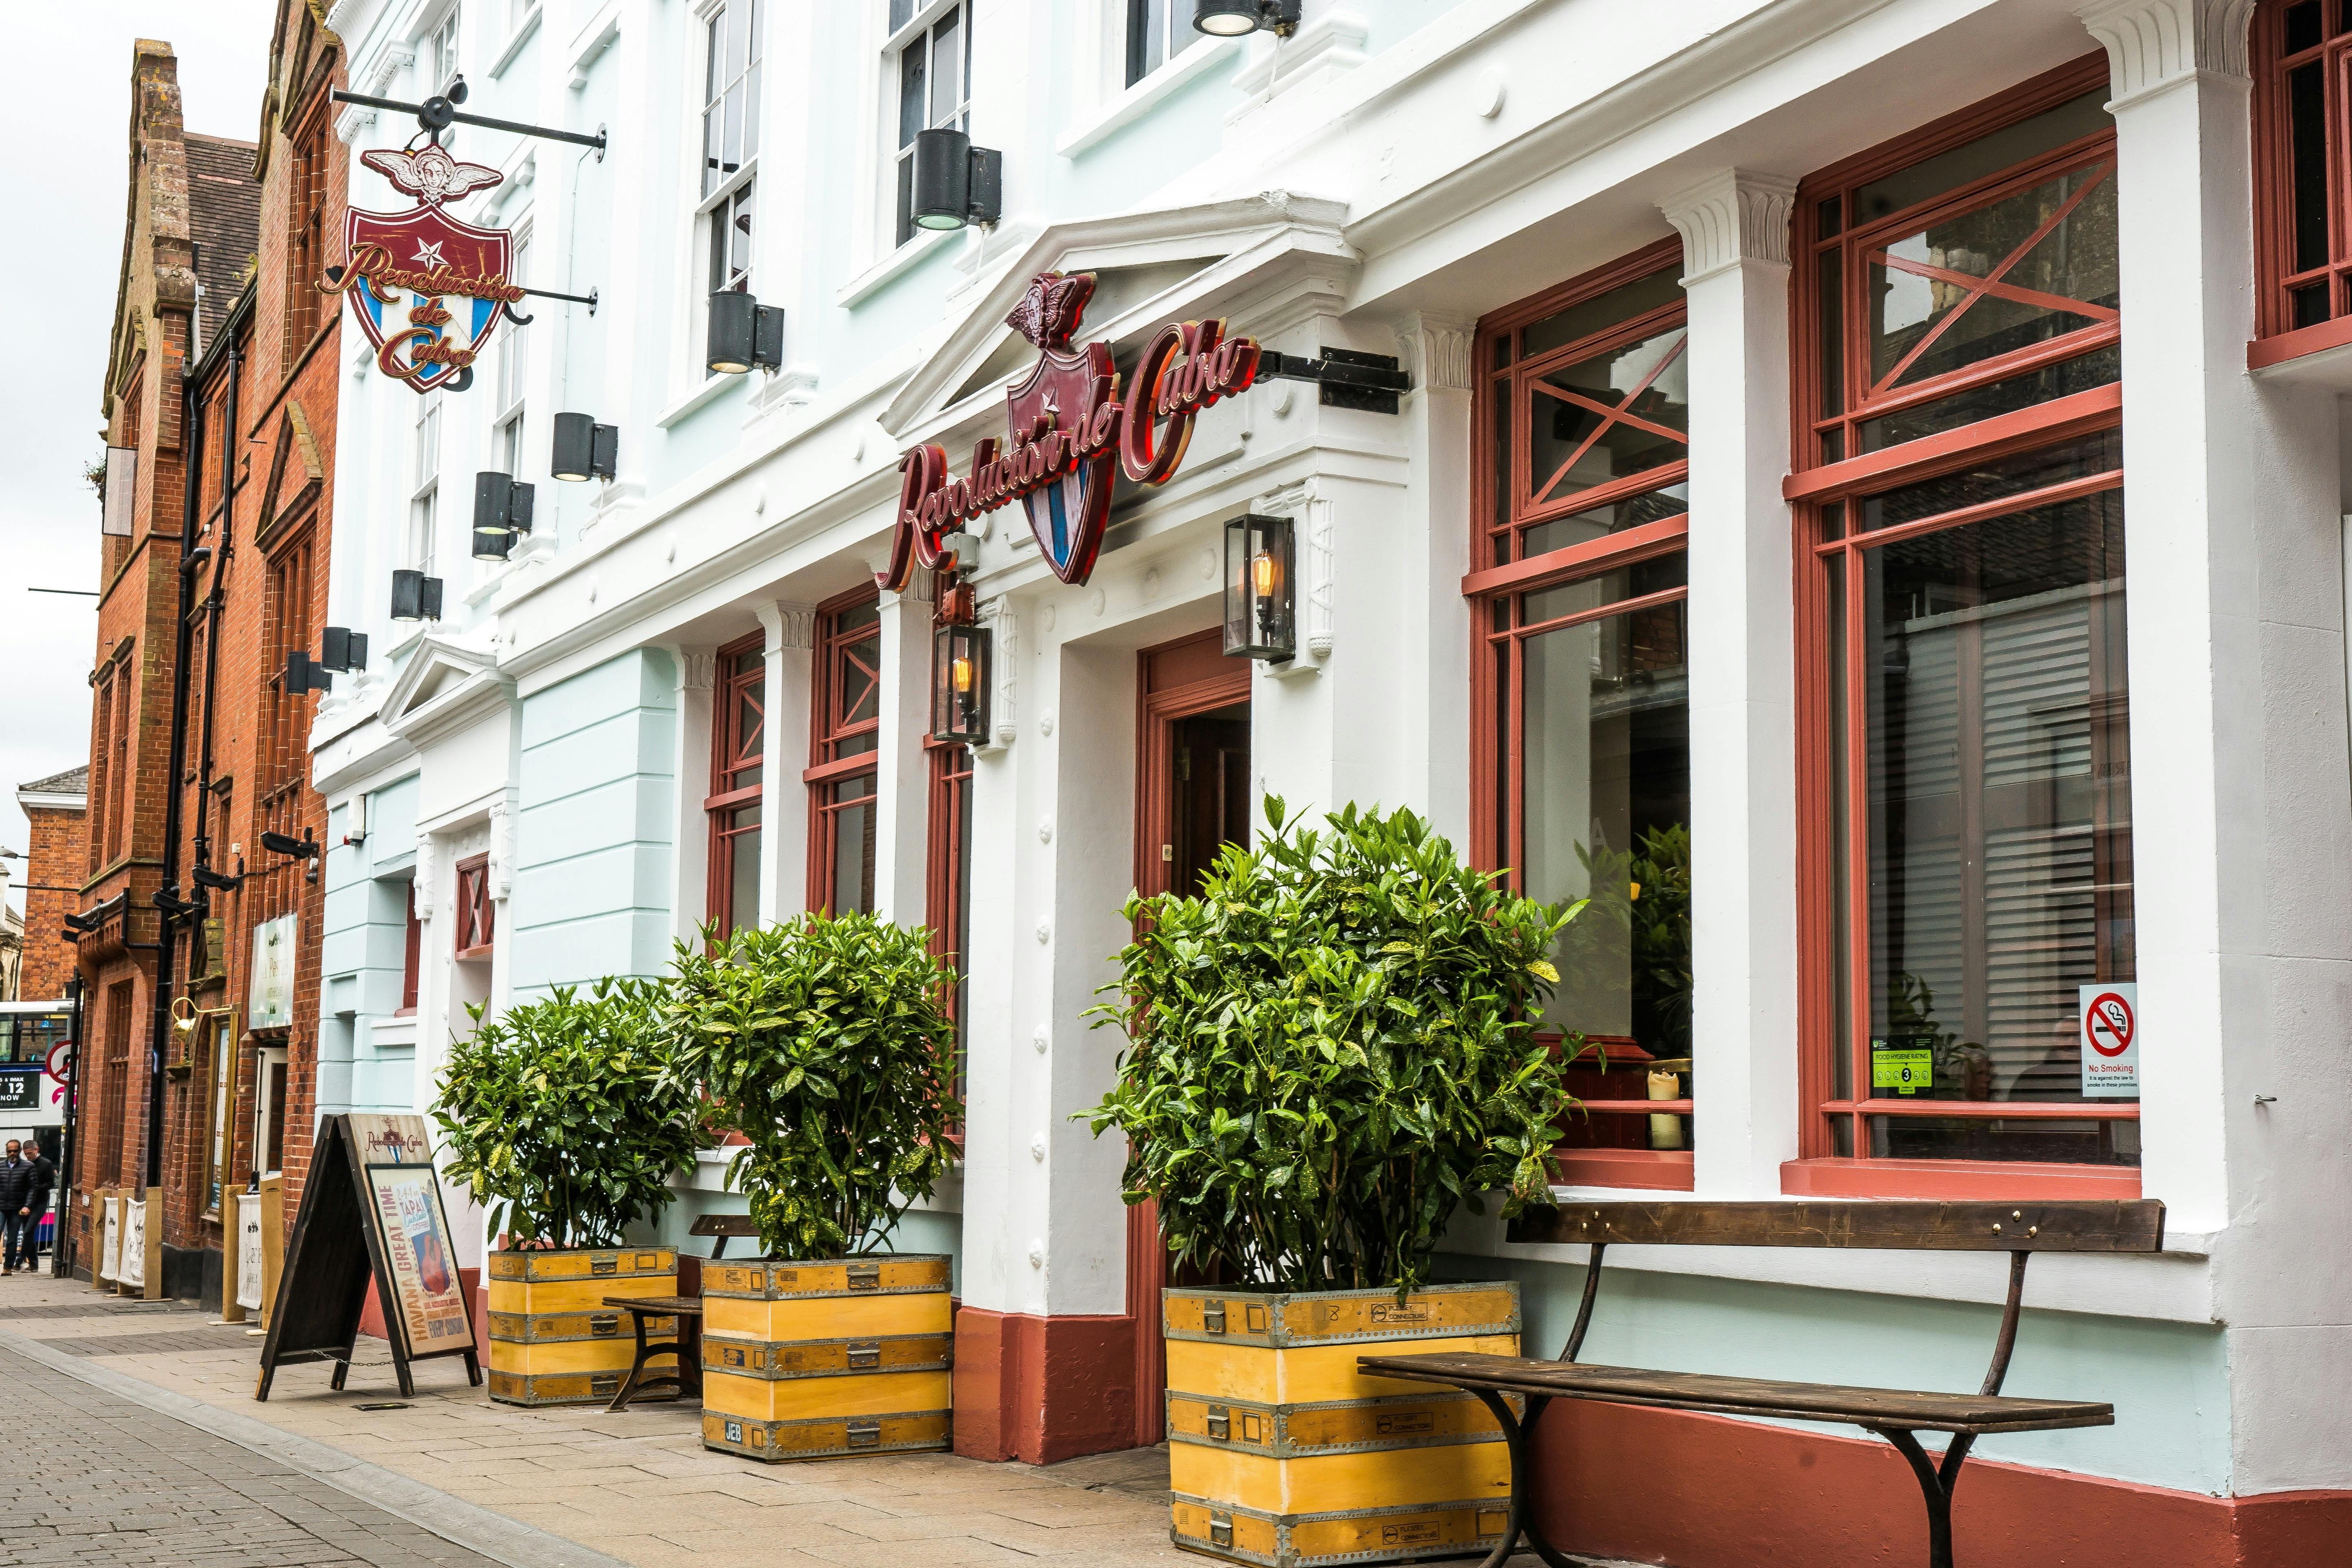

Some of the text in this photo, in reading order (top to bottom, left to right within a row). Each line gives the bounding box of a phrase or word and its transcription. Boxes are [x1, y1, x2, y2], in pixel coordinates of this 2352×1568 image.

[315, 242, 527, 304] Revolución
[408, 297, 452, 326] de
[378, 328, 477, 379] Cuba
[875, 317, 1262, 593] Revolución de Cuba
[1903, 1070, 1909, 1080] 3
[2101, 1064, 2133, 1074] Smoking
[9, 1083, 24, 1093] 12
[378, 1185, 428, 1342] HAVANA GREAT TIME
[726, 1423, 741, 1441] JEB
